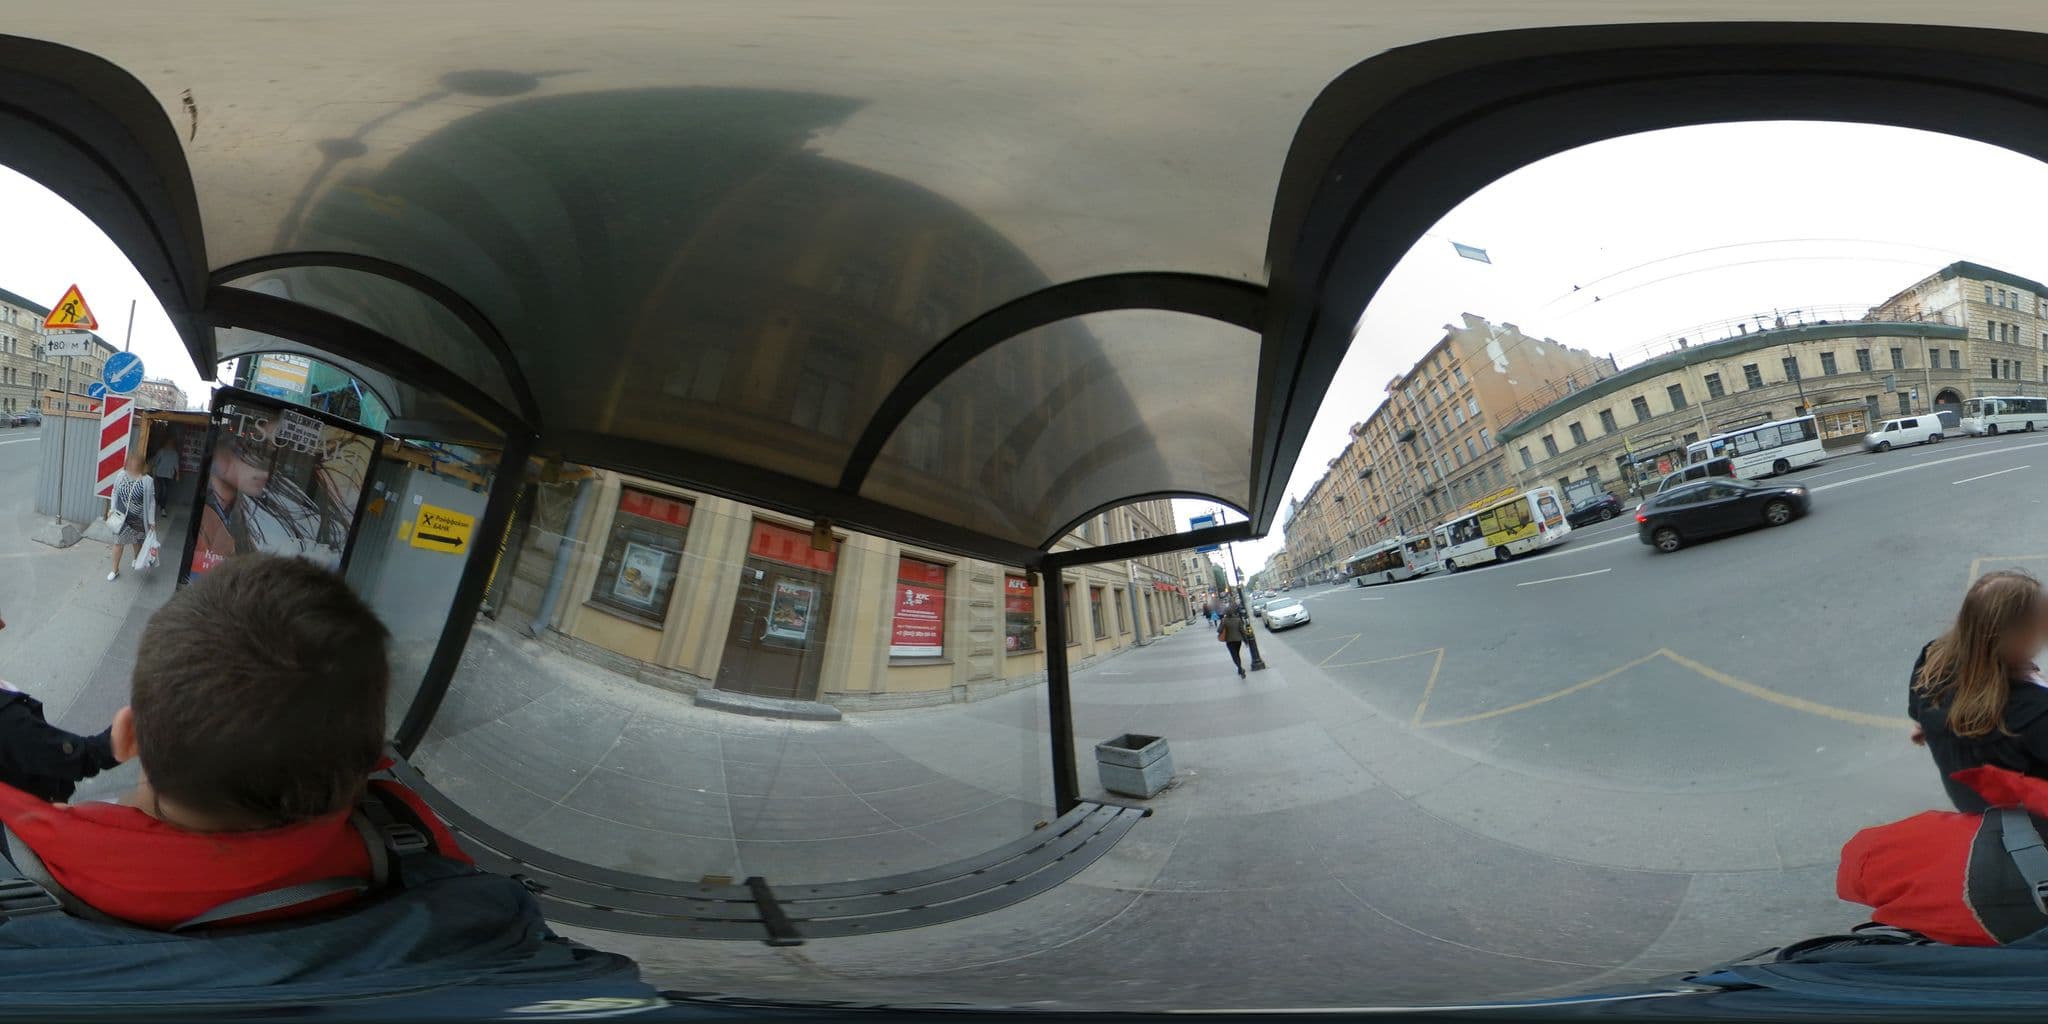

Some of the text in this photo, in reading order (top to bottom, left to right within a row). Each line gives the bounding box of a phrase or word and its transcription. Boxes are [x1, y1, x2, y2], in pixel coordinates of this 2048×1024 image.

[53, 341, 65, 350] 80
[205, 549, 224, 563] Кра
[1008, 578, 1027, 589] KFC
